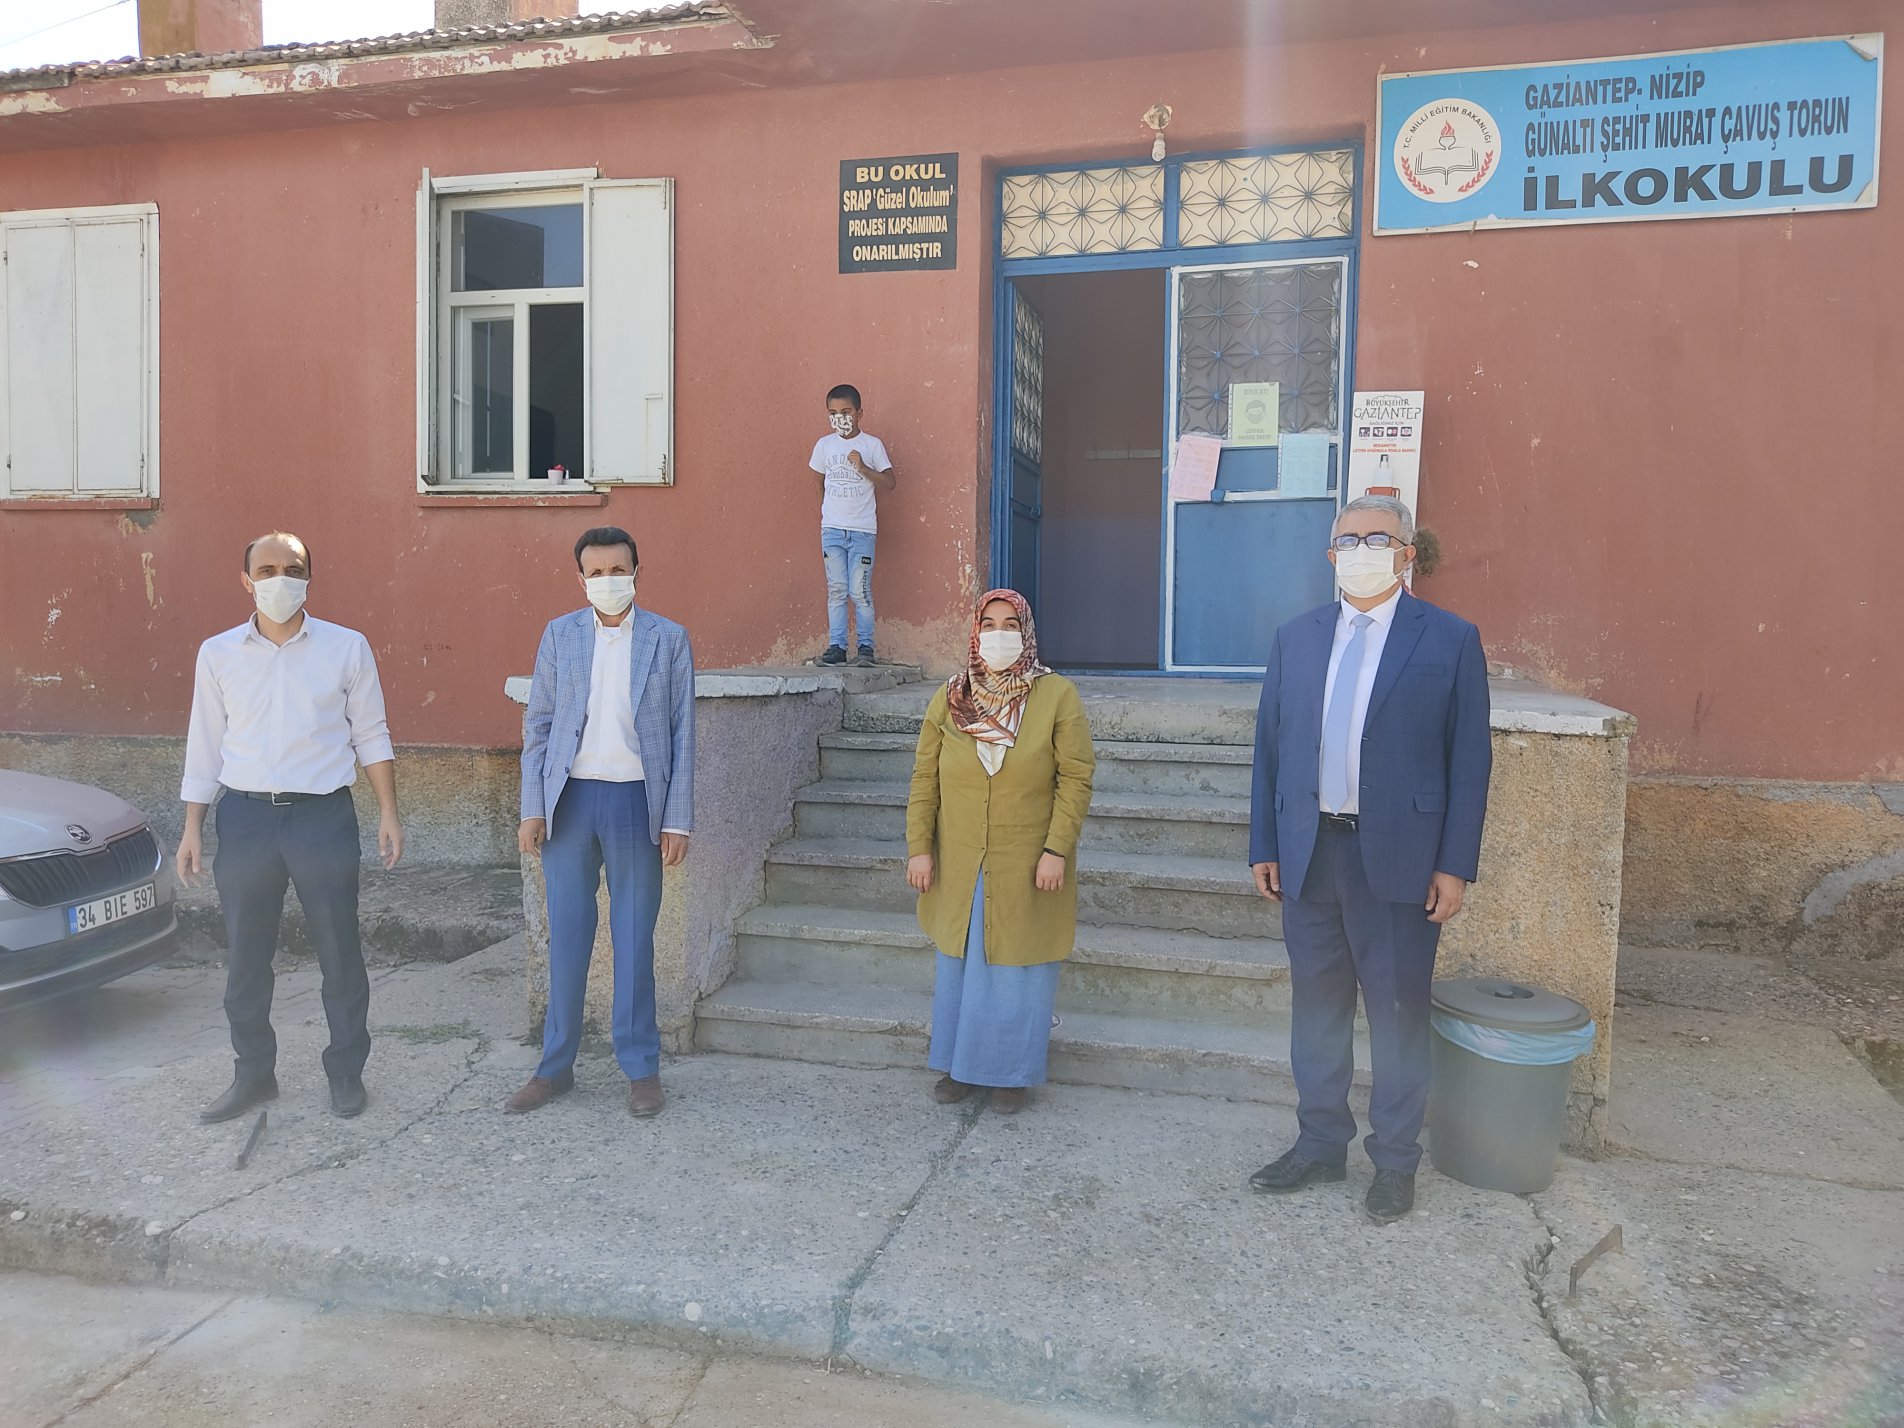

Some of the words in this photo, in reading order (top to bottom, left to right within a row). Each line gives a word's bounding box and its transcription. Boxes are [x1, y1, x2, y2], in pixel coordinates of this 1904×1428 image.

[1650, 63, 1705, 101] NİZİP
[1403, 135, 1413, 149] T.C.
[1410, 113, 1429, 134] MİLLİ
[1430, 105, 1459, 117] EĞİTİM
[1461, 108, 1491, 144] BAKANLIĞI
[1525, 111, 1595, 158] GÜNALTI
[1600, 103, 1650, 163] ŞEHİT
[1655, 107, 1716, 149] MURAT
[1720, 101, 1781, 155] ÇAVUŞ
[1787, 96, 1850, 138] TORUN
[856, 166, 884, 183] BU
[890, 163, 946, 181] OKUL
[1523, 154, 1854, 211] İLKOKULU
[843, 188, 872, 212] SRAP
[887, 215, 948, 235] KAPSAMINDA
[852, 242, 942, 262] ONARILMIŞTIR
[78, 905, 96, 929] 34
[104, 895, 128, 921] BIE
[133, 886, 153, 911] 597
